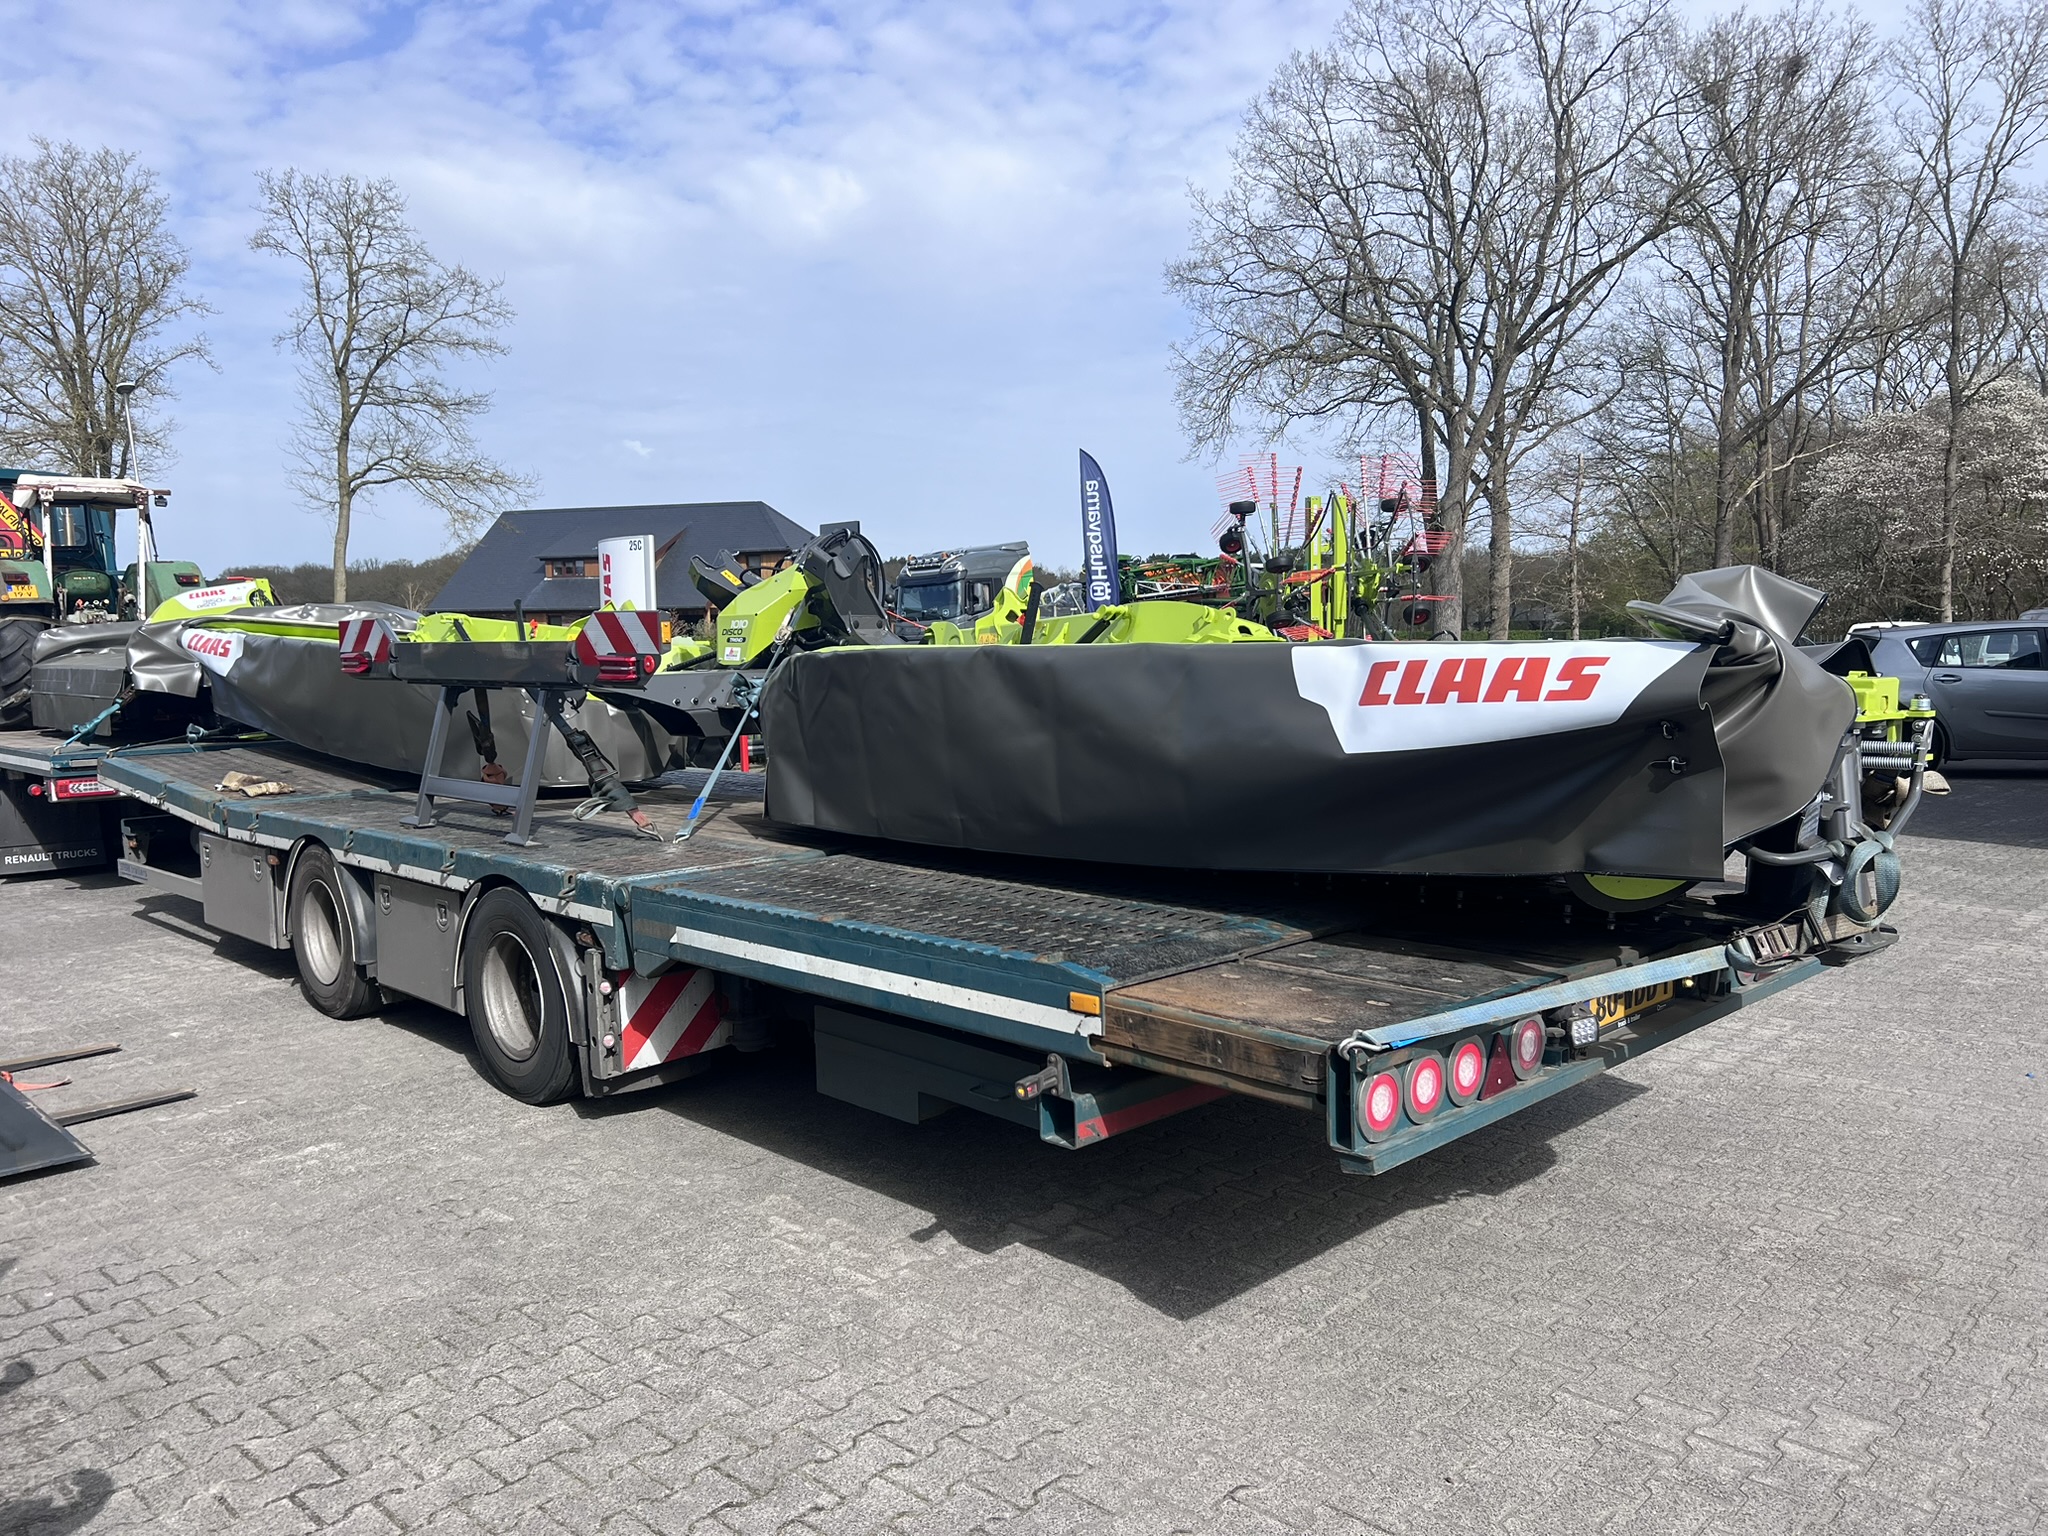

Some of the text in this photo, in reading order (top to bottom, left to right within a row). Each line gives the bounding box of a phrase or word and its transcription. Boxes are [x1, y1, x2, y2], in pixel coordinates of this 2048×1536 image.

[629, 540, 642, 551] 25C
[189, 588, 226, 599] CLAAS
[721, 628, 743, 636] DISCO
[187, 633, 232, 658] CLAAS
[1358, 656, 1611, 706] CLAAS
[4, 848, 98, 865] RENAULT TRUCKS
